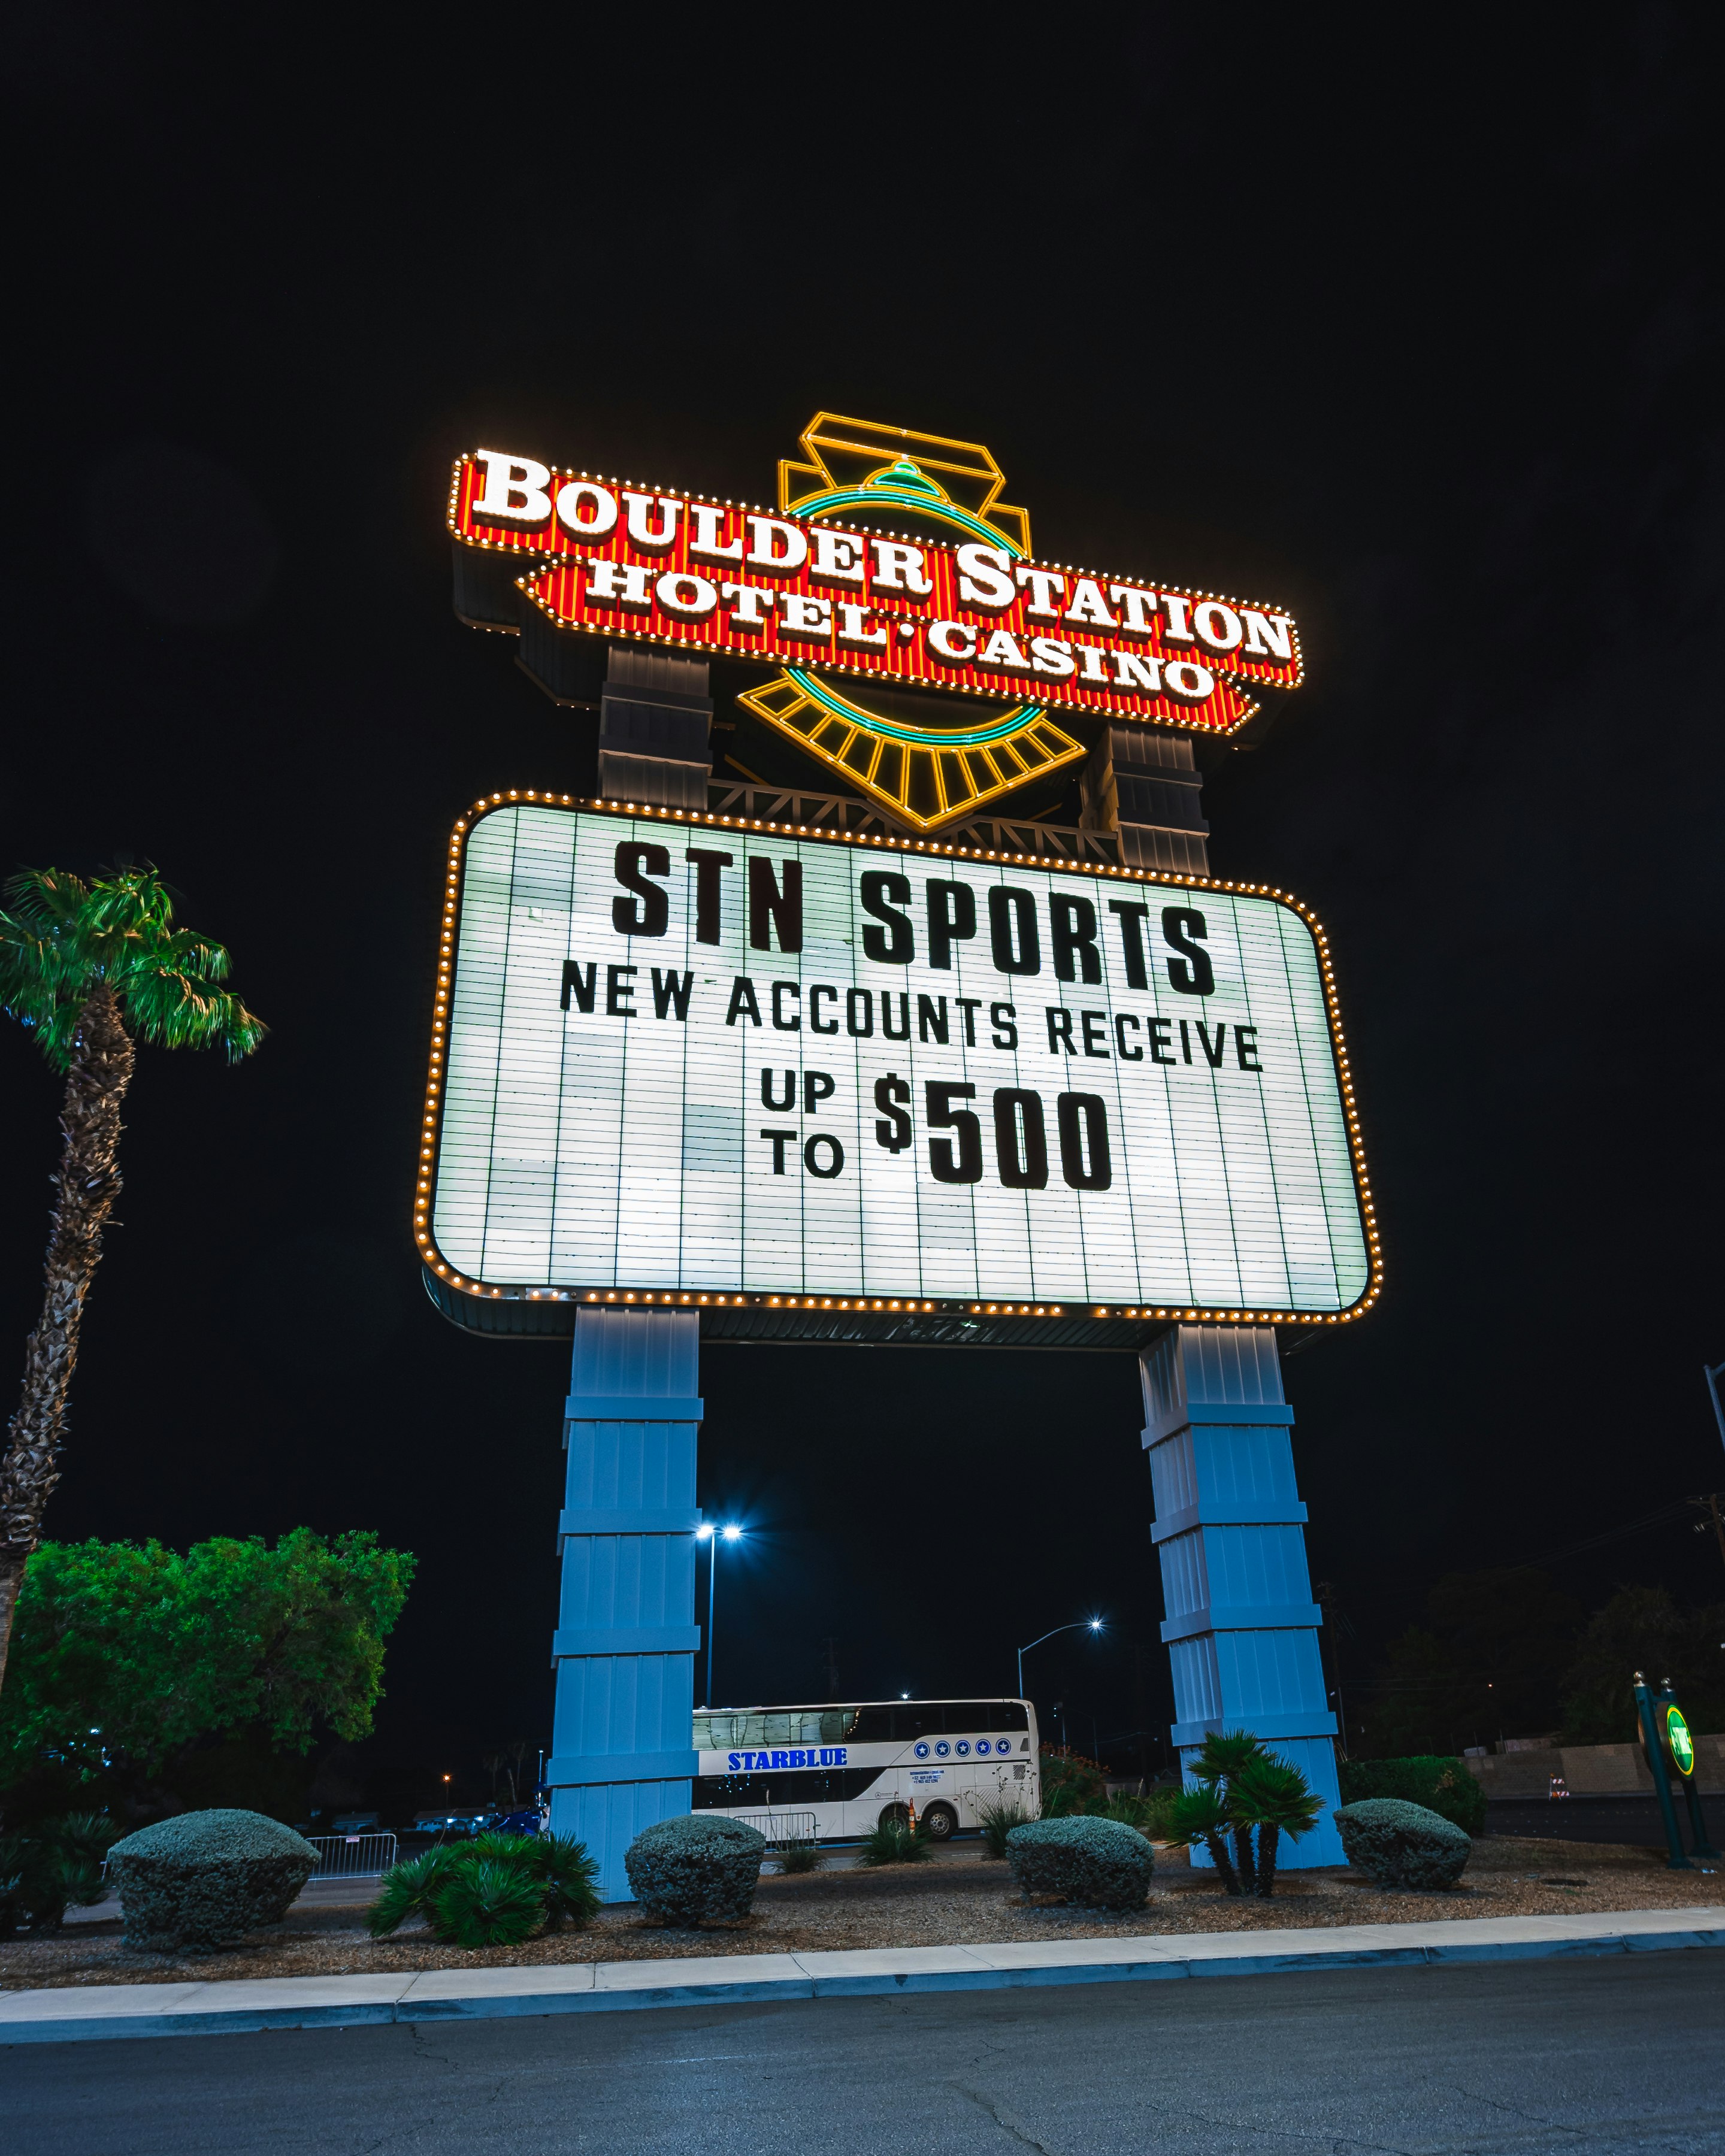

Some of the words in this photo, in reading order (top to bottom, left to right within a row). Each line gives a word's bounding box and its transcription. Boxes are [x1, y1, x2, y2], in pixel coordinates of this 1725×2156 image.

[471, 449, 934, 593] BOULDER
[957, 543, 1296, 659] STATION
[585, 556, 888, 645] HOTEL
[927, 620, 1215, 698] CASINO
[612, 840, 803, 953] STN
[859, 870, 1215, 998] SPORTS
[559, 959, 695, 1023] NEW
[725, 976, 1018, 1052] ACCOUNTS
[1045, 1007, 1264, 1074] RECEIVE
[760, 1128, 844, 1179] TO
[761, 1068, 836, 1114] UP
[874, 1072, 1113, 1191] $500
[728, 1748, 848, 1771] STARBLUE
